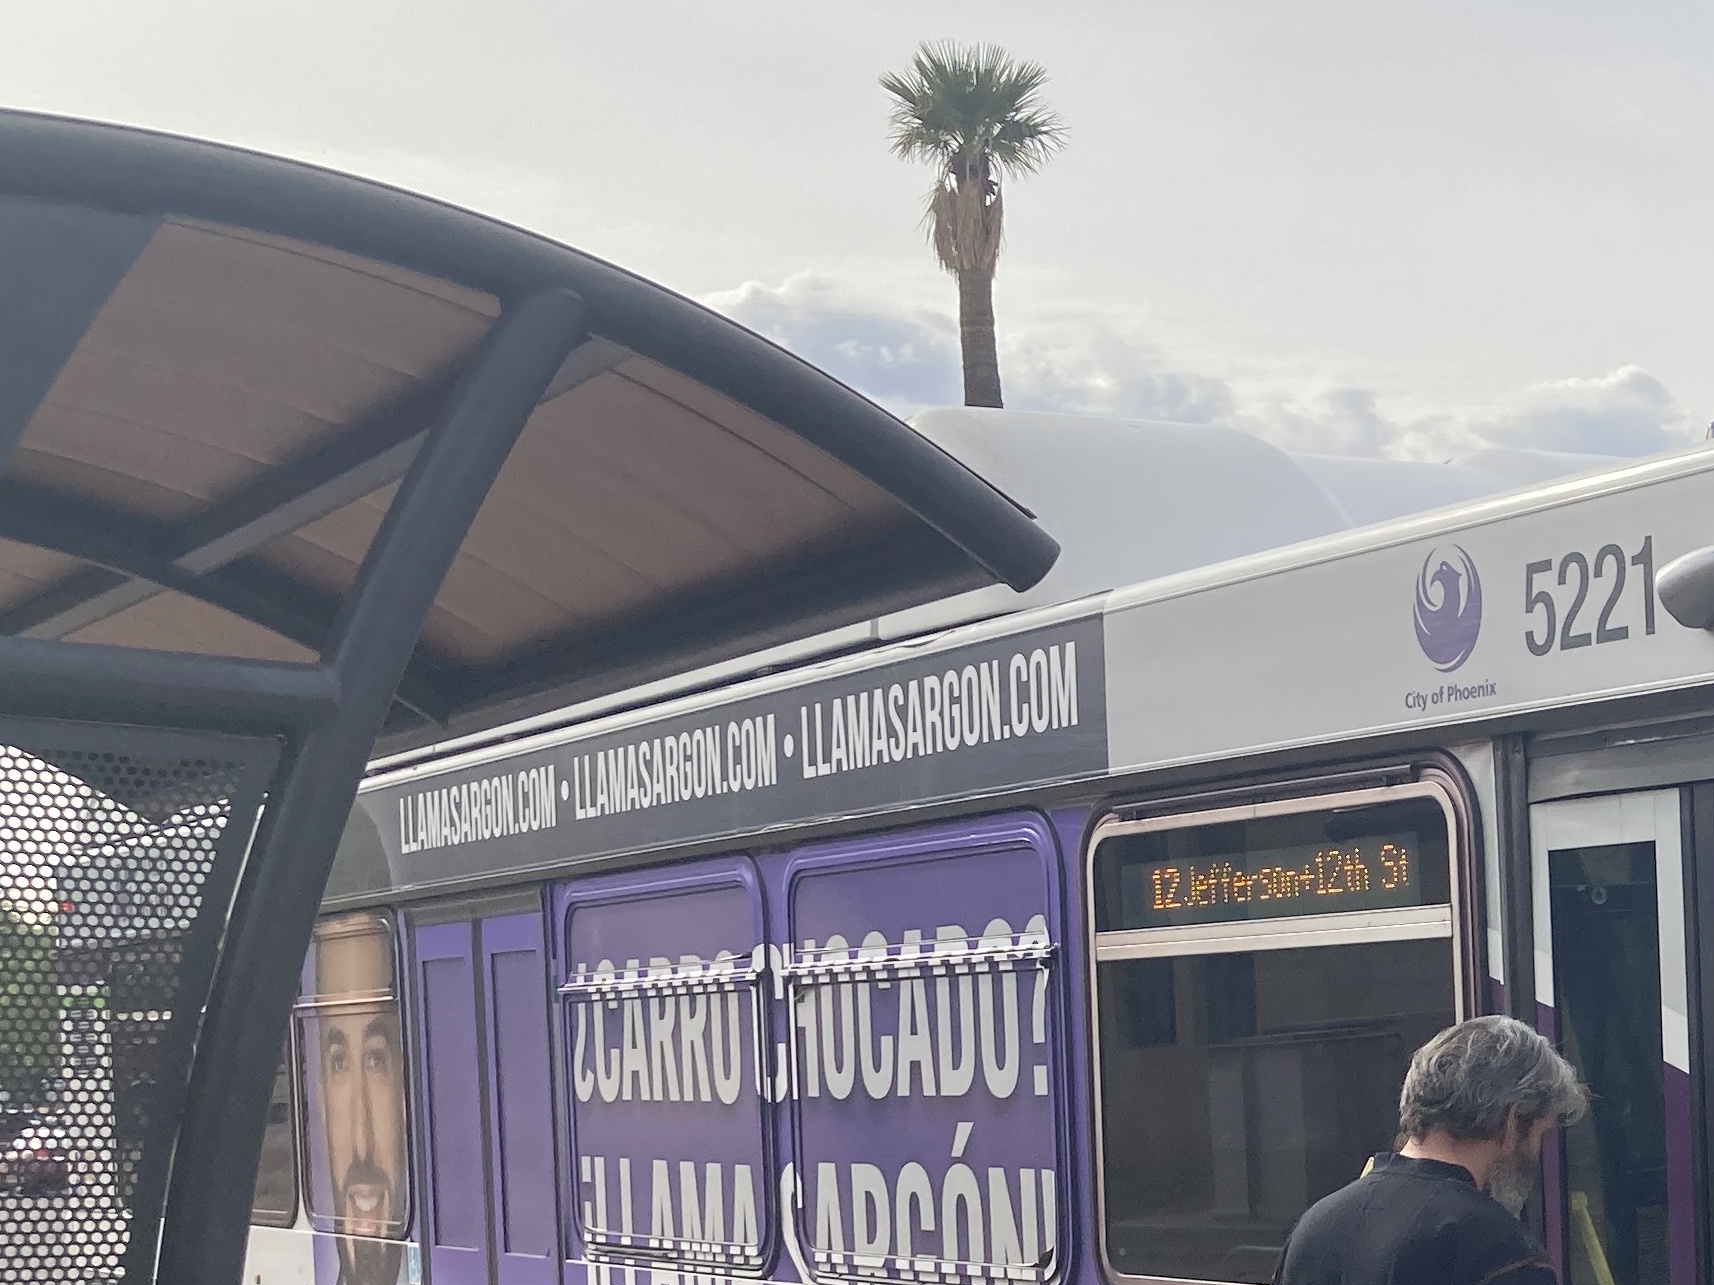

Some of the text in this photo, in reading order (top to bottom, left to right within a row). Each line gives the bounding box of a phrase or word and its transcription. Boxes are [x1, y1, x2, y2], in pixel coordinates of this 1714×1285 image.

[1524, 534, 1656, 657] 5221
[399, 640, 1079, 855] LLAMASARGON.COM LLAMASARGON.COM LLAMASARGON.COM
[1405, 678, 1497, 712] City of Phoenix
[1151, 867, 1182, 909] 12
[1381, 842, 1410, 890] St
[571, 950, 741, 1105] ¿CARRO
